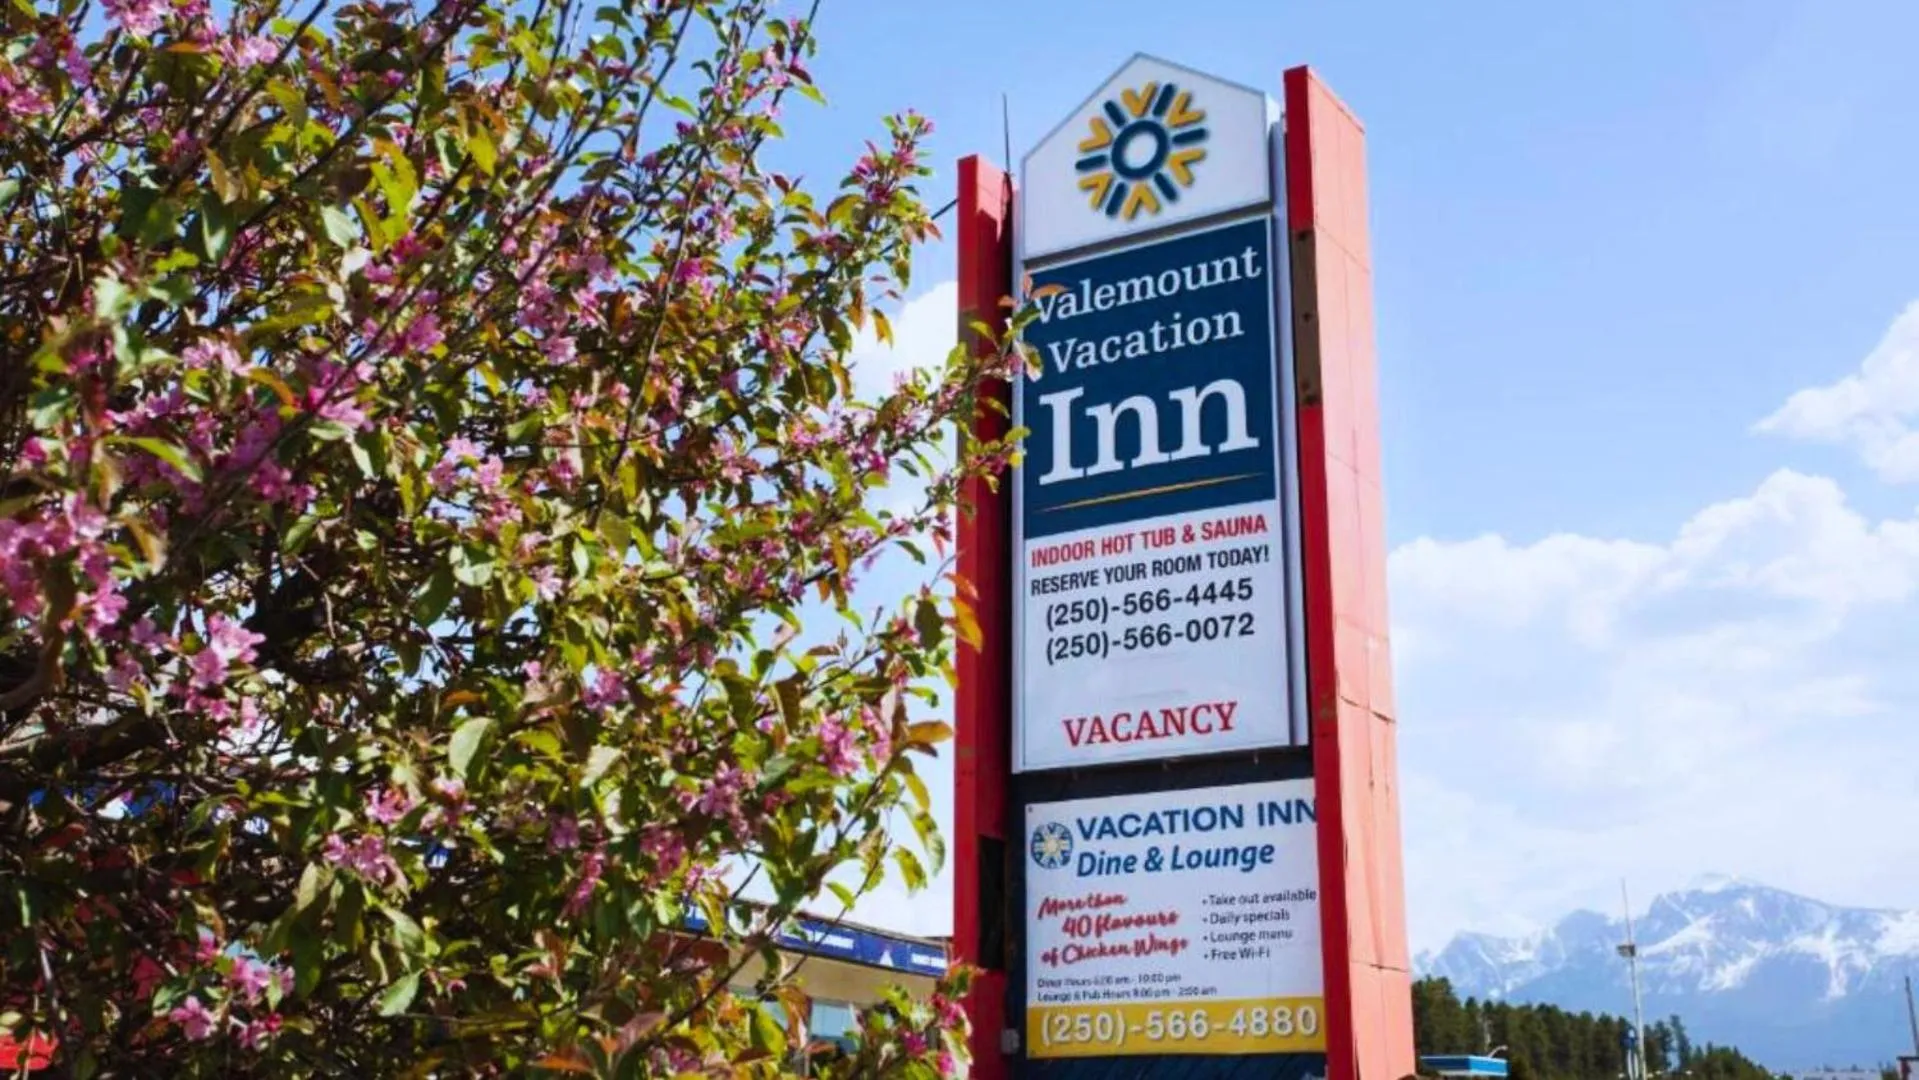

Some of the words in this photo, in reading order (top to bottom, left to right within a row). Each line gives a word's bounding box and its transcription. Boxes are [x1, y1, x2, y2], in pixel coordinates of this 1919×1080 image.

[1034, 246, 1262, 324] Valemount
[1048, 310, 1244, 373] Vacation
[1039, 378, 1259, 485] Inn
[1031, 540, 1095, 568] INDOOR
[1101, 533, 1135, 554] HOT
[1141, 527, 1175, 550] TUB
[1182, 524, 1195, 543] &
[1201, 514, 1268, 540] SAUNA
[1031, 569, 1099, 596] RESERVE
[1103, 561, 1146, 585] YOUR
[1152, 555, 1201, 578] ROOM
[1207, 545, 1269, 570] TODAY!
[1046, 577, 1254, 632] (250)-566-4445
[1046, 612, 1255, 665] (250)-566-0072
[1063, 701, 1238, 747] VACANCY
[1076, 804, 1244, 841] VACATION
[1257, 799, 1318, 827] INN
[1076, 850, 1138, 877] Dine
[1144, 846, 1165, 872] &
[1171, 843, 1275, 873] Lounge
[1209, 894, 1236, 905] Take
[1238, 893, 1260, 904] out
[1262, 888, 1317, 904] available
[1210, 911, 1240, 926] Daily
[1243, 908, 1290, 925] specials
[1062, 914, 1092, 938] 40
[1210, 931, 1256, 944] Lounge
[1259, 930, 1293, 940] menu
[1041, 947, 1058, 968] of
[1062, 942, 1131, 965] Chicken
[1211, 948, 1237, 960] Free
[1041, 1006, 1318, 1047] (250)-566-4880
